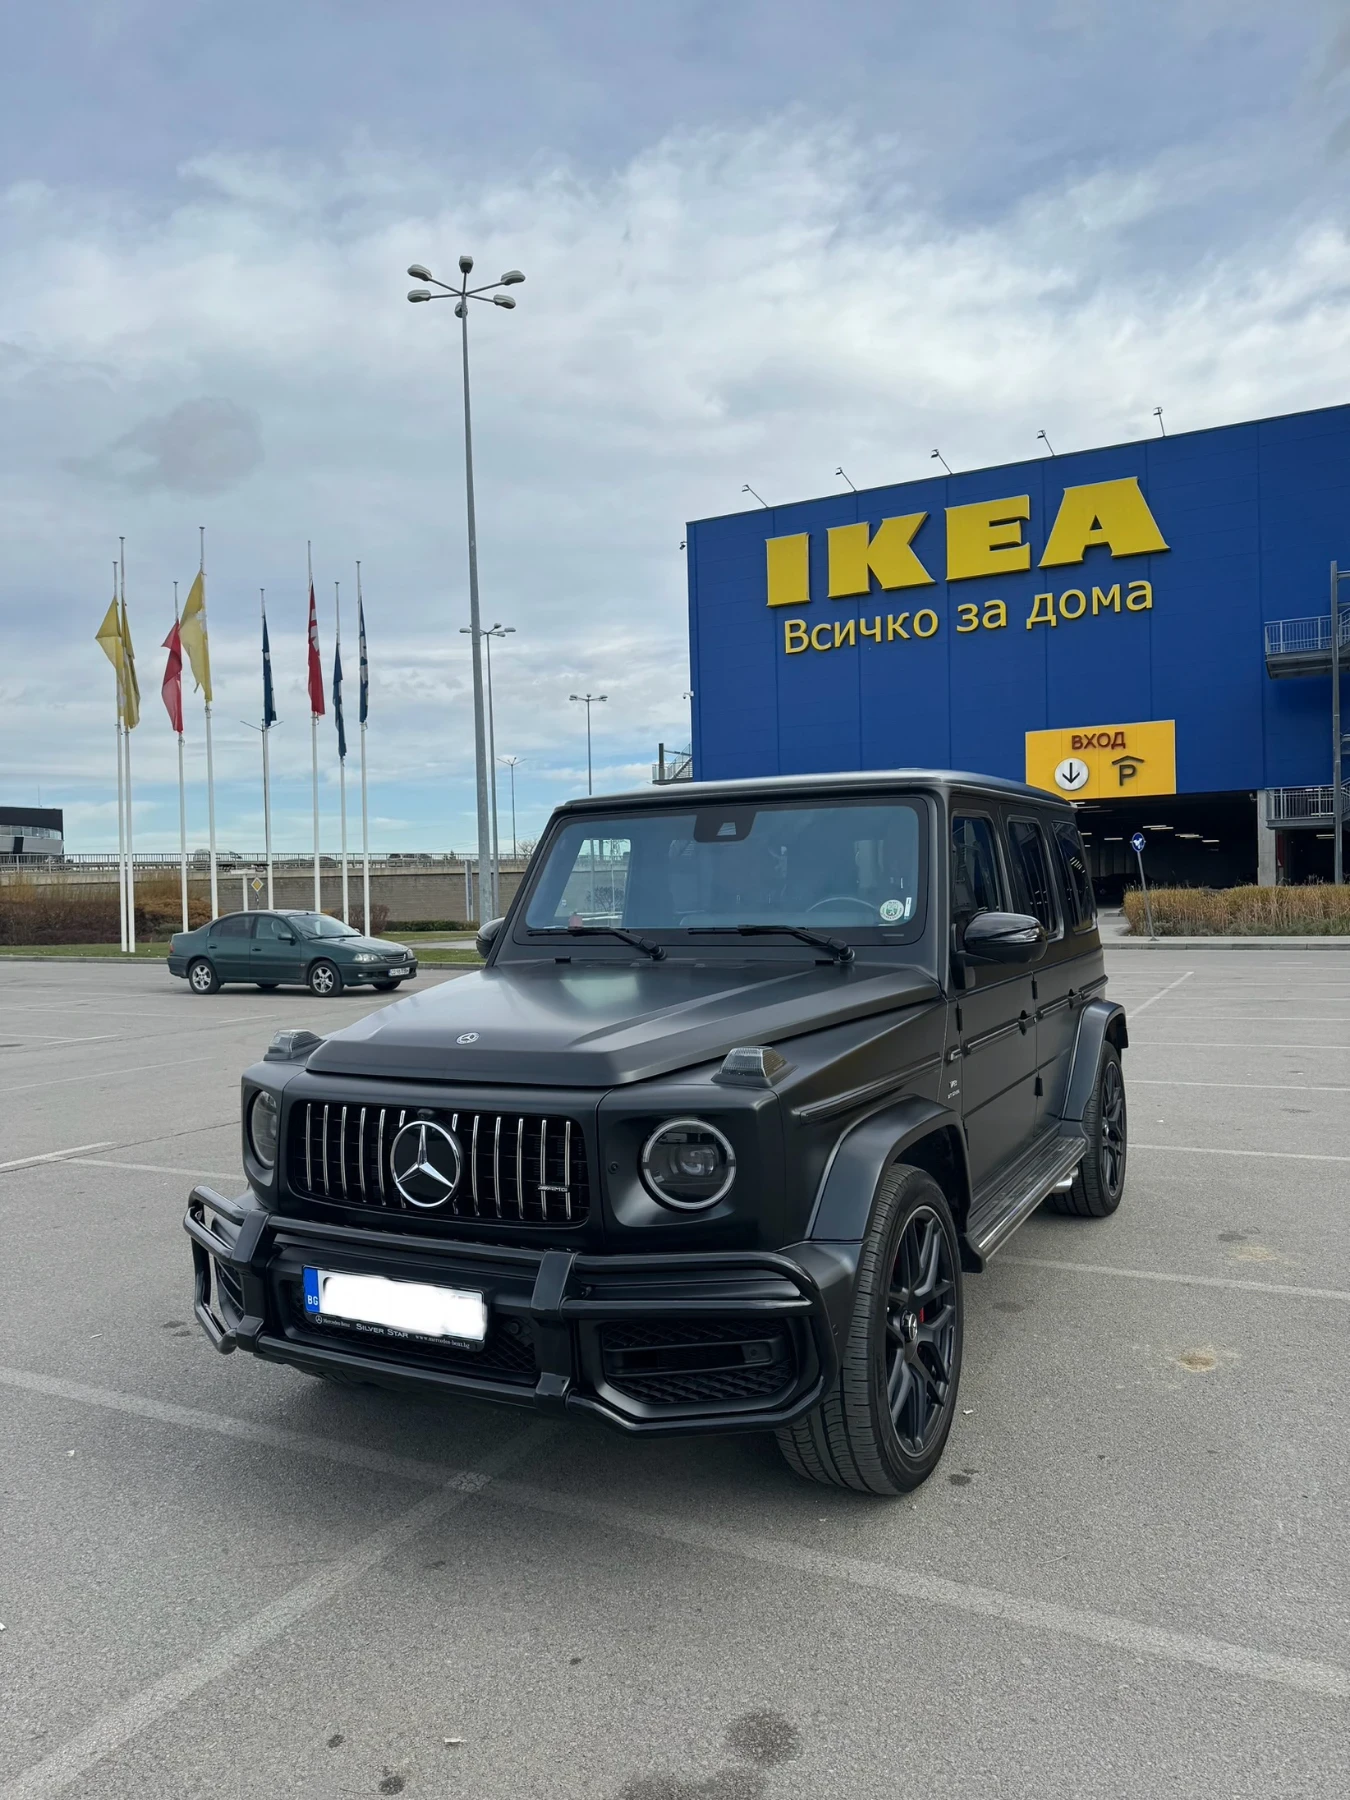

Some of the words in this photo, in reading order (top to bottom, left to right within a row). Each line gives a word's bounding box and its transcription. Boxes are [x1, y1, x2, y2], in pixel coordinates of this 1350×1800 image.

[765, 476, 1170, 607] IKEA
[783, 609, 939, 654] Всичко
[956, 599, 1007, 633] за
[1026, 580, 1153, 630] дома
[1071, 731, 1126, 750] ВХОД
[307, 1294, 319, 1306] BG
